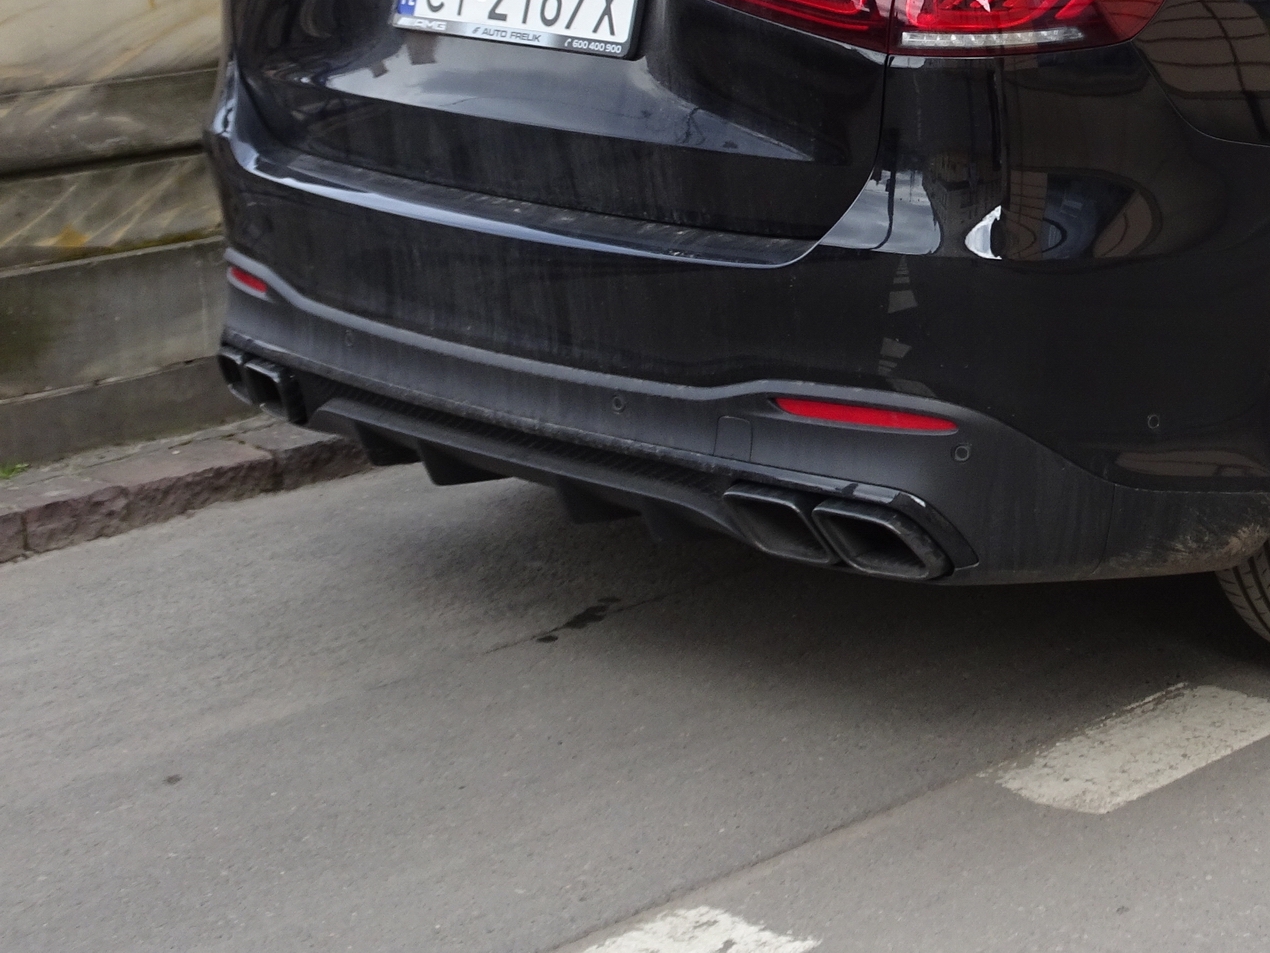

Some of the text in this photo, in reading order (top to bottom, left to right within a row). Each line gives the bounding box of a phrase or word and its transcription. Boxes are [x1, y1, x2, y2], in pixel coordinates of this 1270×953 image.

[414, 18, 448, 31] AMG
[481, 28, 542, 43] AUTO FRELIK
[572, 39, 622, 54] 600 400 900
